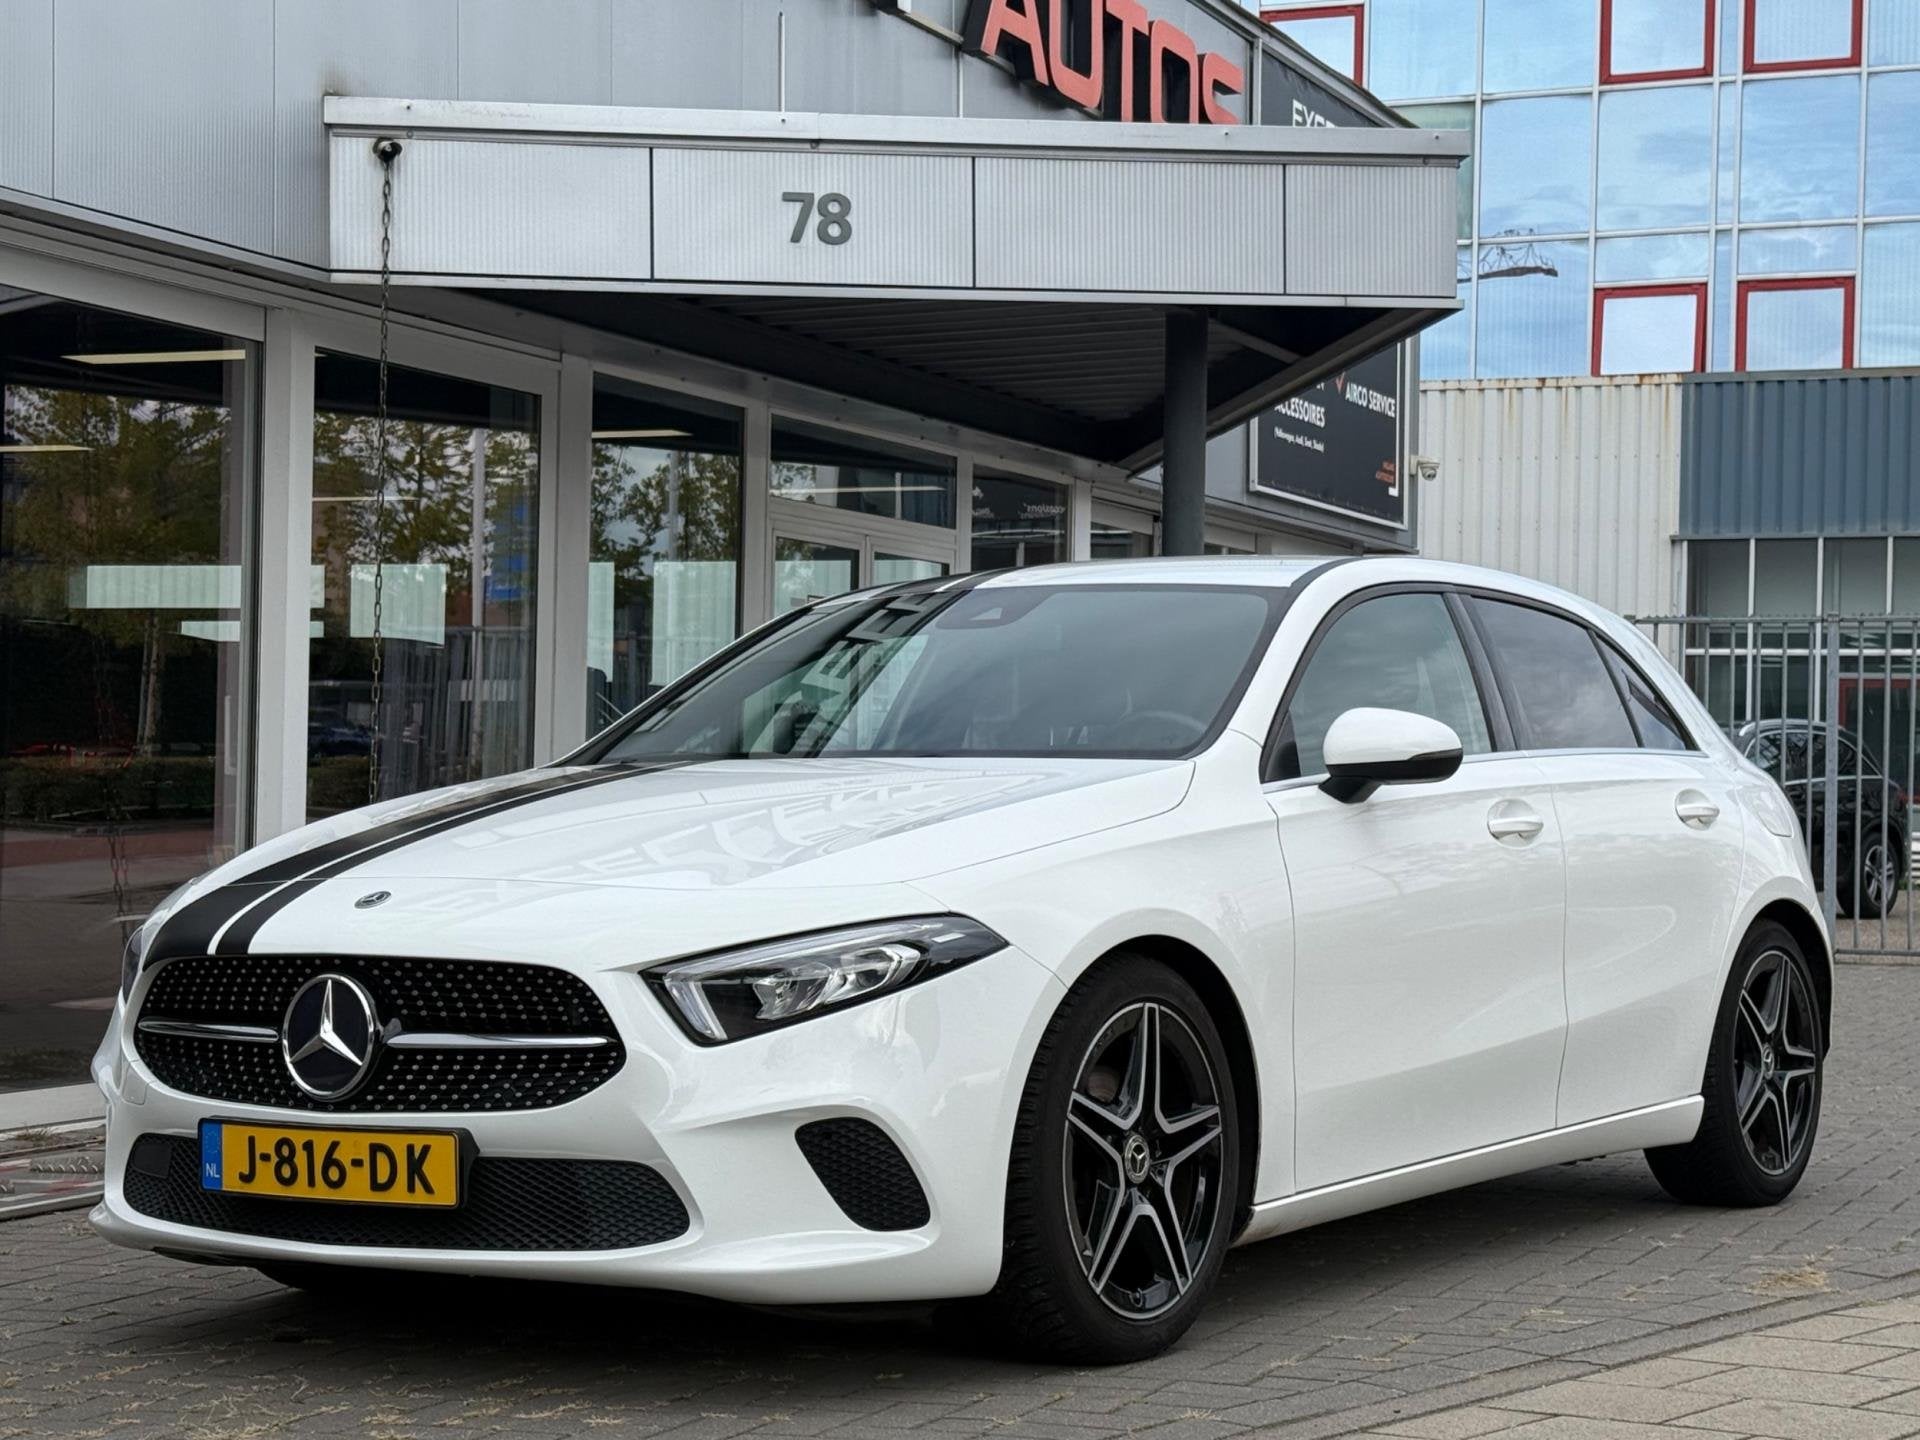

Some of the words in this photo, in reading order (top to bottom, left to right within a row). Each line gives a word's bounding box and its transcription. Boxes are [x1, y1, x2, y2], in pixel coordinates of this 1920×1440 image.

[782, 192, 852, 245] 78
[1345, 382, 1368, 407] AIRCO
[1369, 390, 1396, 418] SERVICE
[205, 1163, 220, 1178] NL
[238, 1135, 435, 1195] J-816-DK
